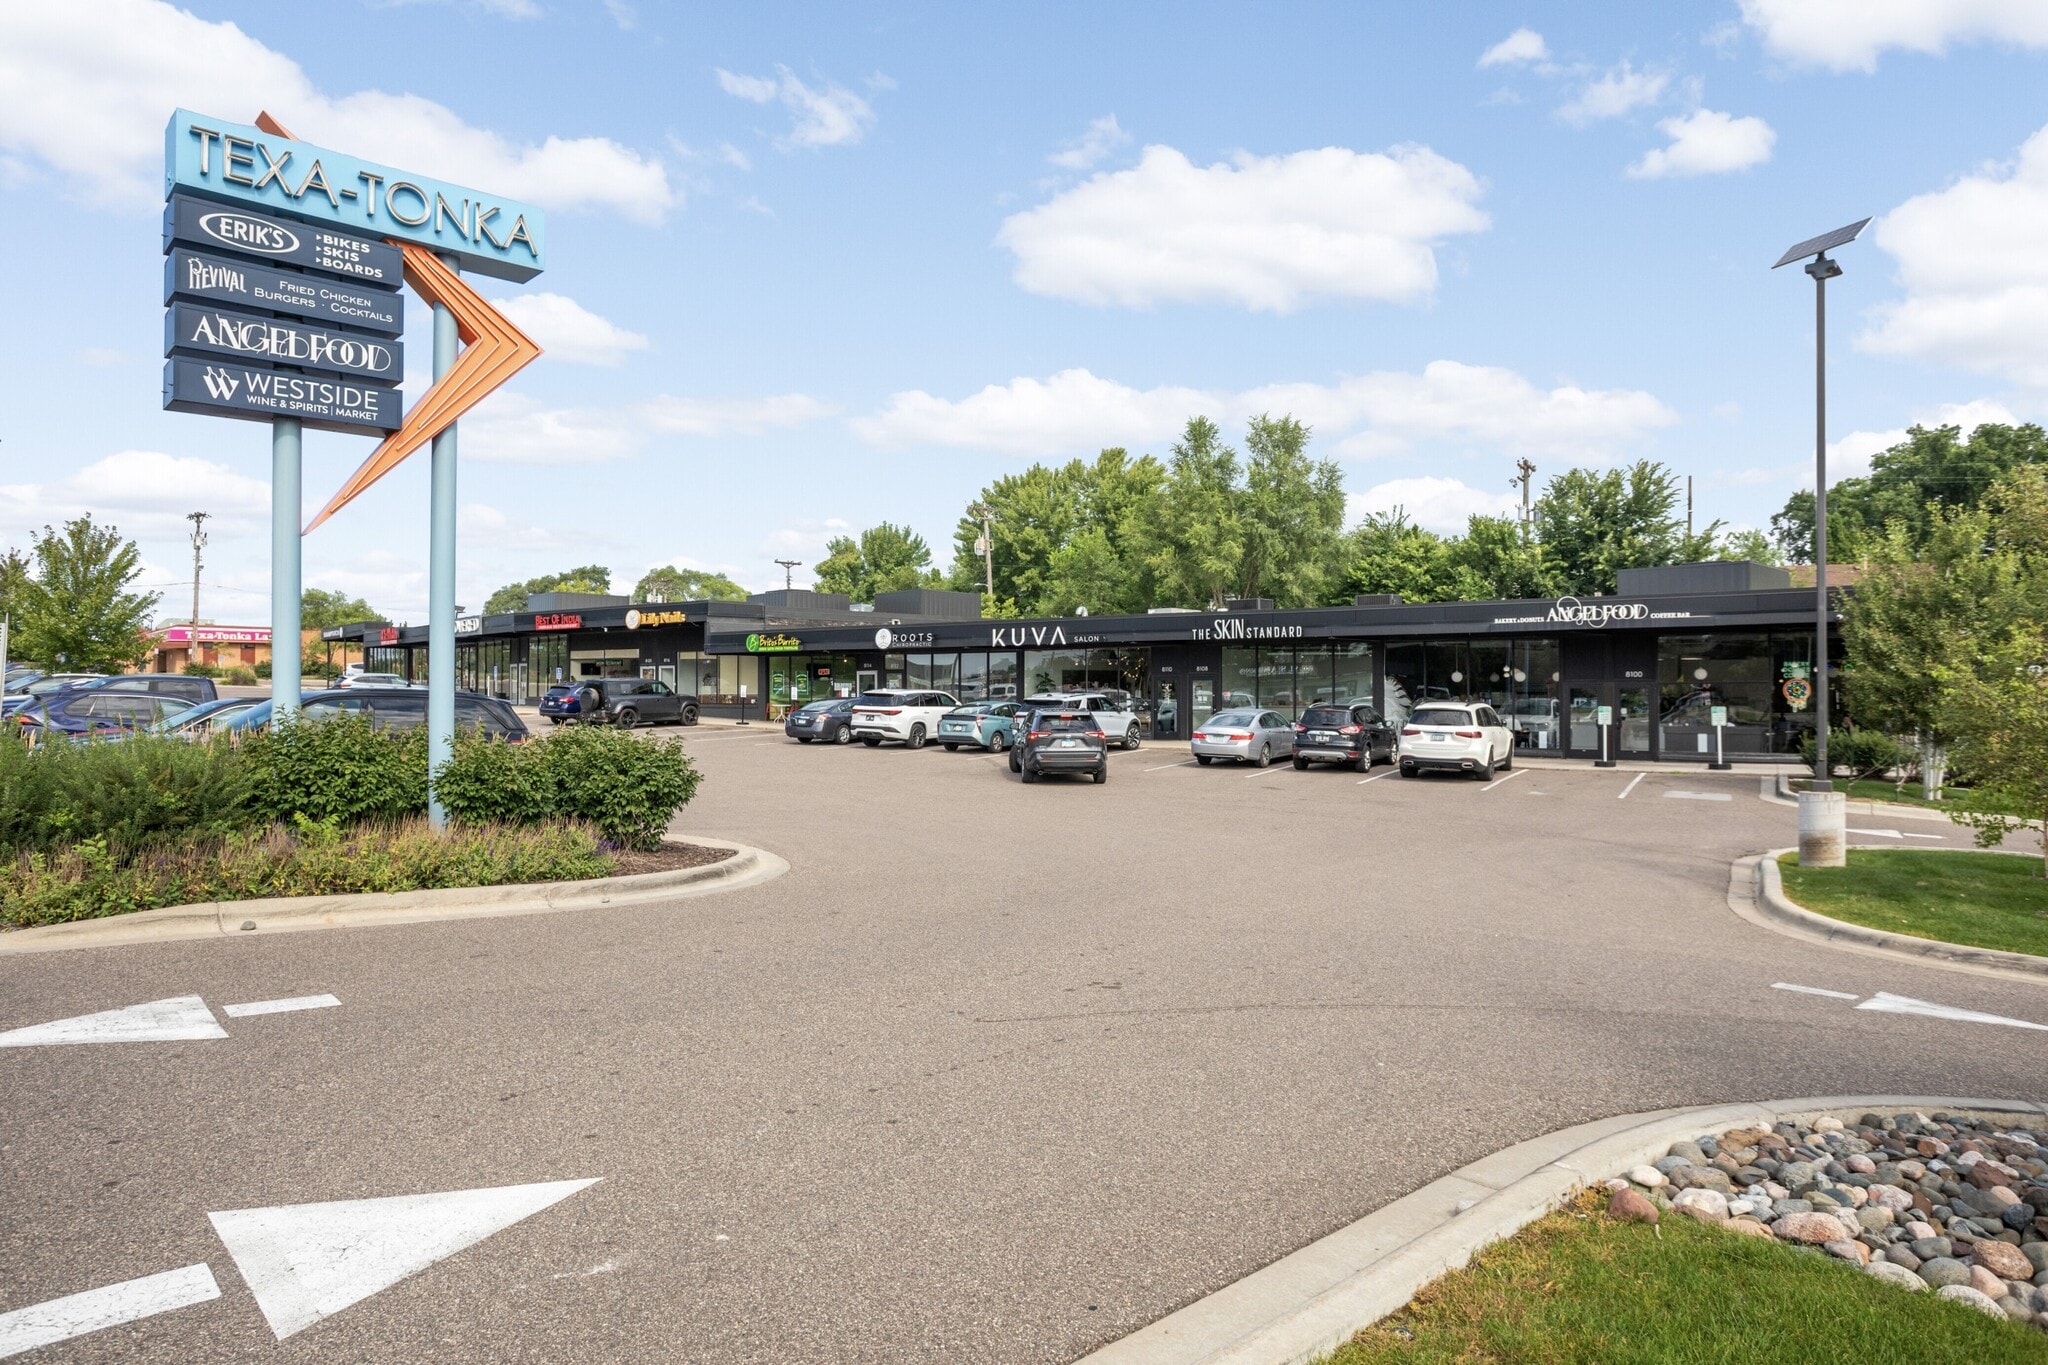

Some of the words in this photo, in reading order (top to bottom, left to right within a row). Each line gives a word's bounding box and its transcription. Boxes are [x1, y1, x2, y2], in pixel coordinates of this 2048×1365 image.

[189, 124, 538, 256] TEXA-TONKA
[220, 217, 284, 248] ERIK'S
[323, 234, 370, 253] BIKES
[323, 246, 360, 262] SKIS
[188, 257, 247, 293] REVIVAL
[322, 257, 383, 278] BOARDS
[245, 372, 379, 411] WESTSIDE
[246, 395, 277, 408] WINE
[279, 399, 288, 409] &
[289, 401, 329, 414] SPIRITS
[335, 408, 378, 421] MARKET
[185, 631, 251, 641] Txa-Tonka
[892, 632, 933, 642] ROOTS
[992, 626, 1067, 647] KUVA
[1192, 629, 1211, 640] THE
[1213, 618, 1244, 640] SKIN
[1246, 626, 1302, 639] STANDARD
[1625, 670, 1643, 678] 8100
